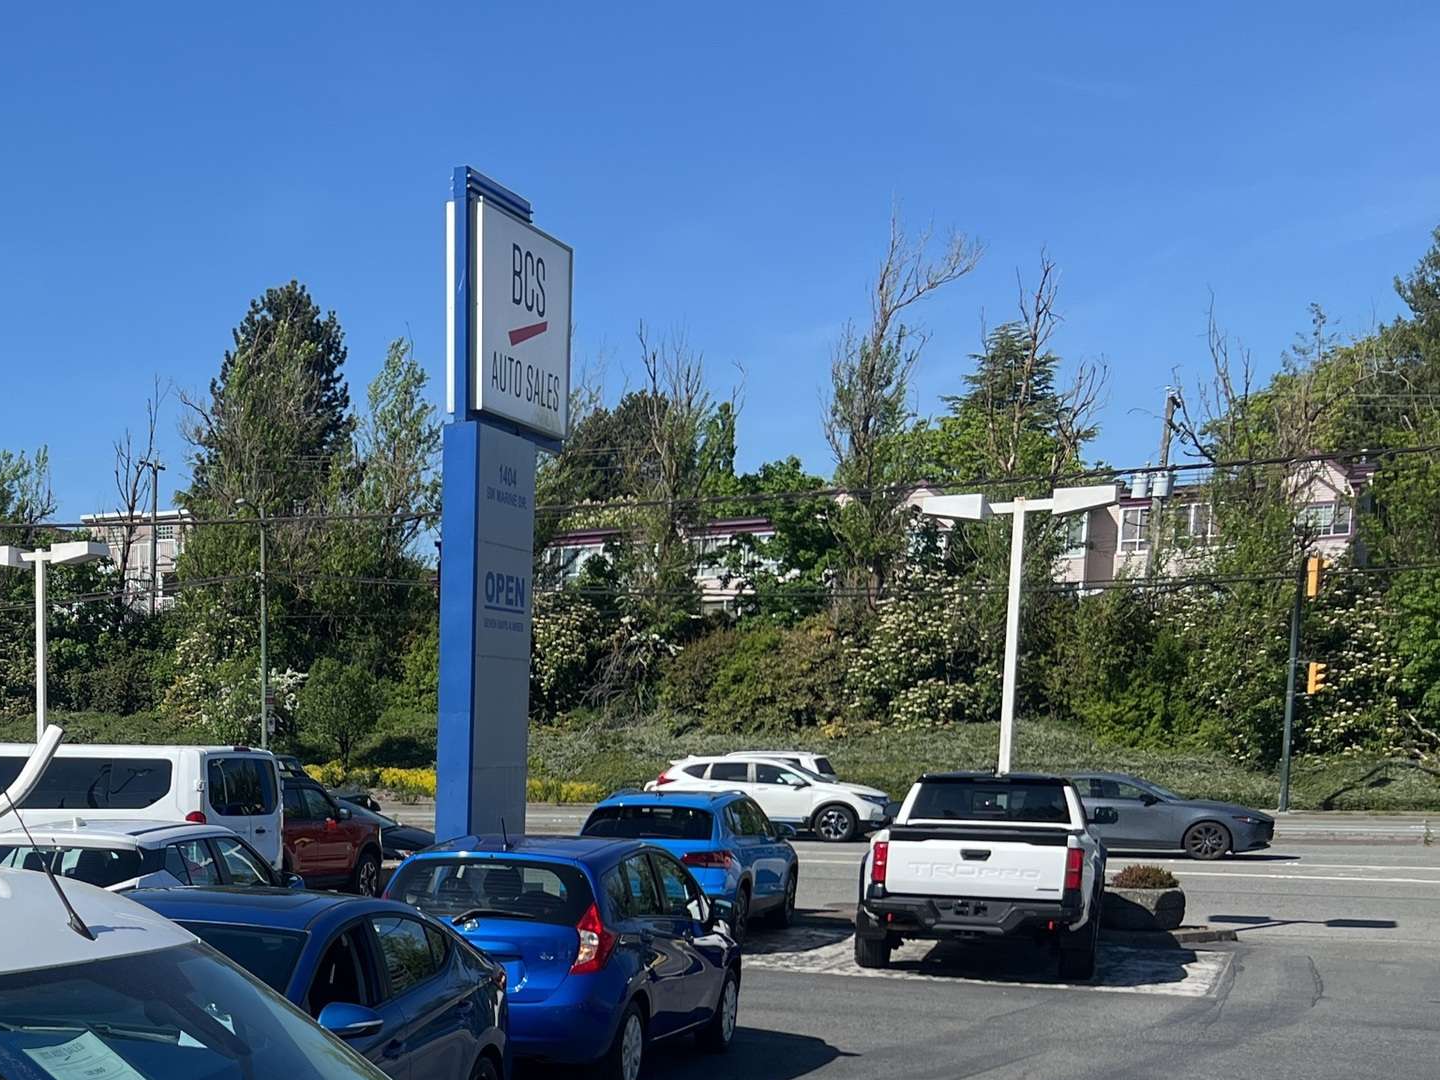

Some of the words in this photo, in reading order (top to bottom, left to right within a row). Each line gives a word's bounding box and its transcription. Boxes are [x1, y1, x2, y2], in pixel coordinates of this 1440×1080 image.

[512, 242, 546, 317] BCS
[491, 351, 522, 398] AUTO
[526, 364, 560, 412] SALES
[499, 464, 517, 488] 1404
[485, 571, 525, 608] OPEN
